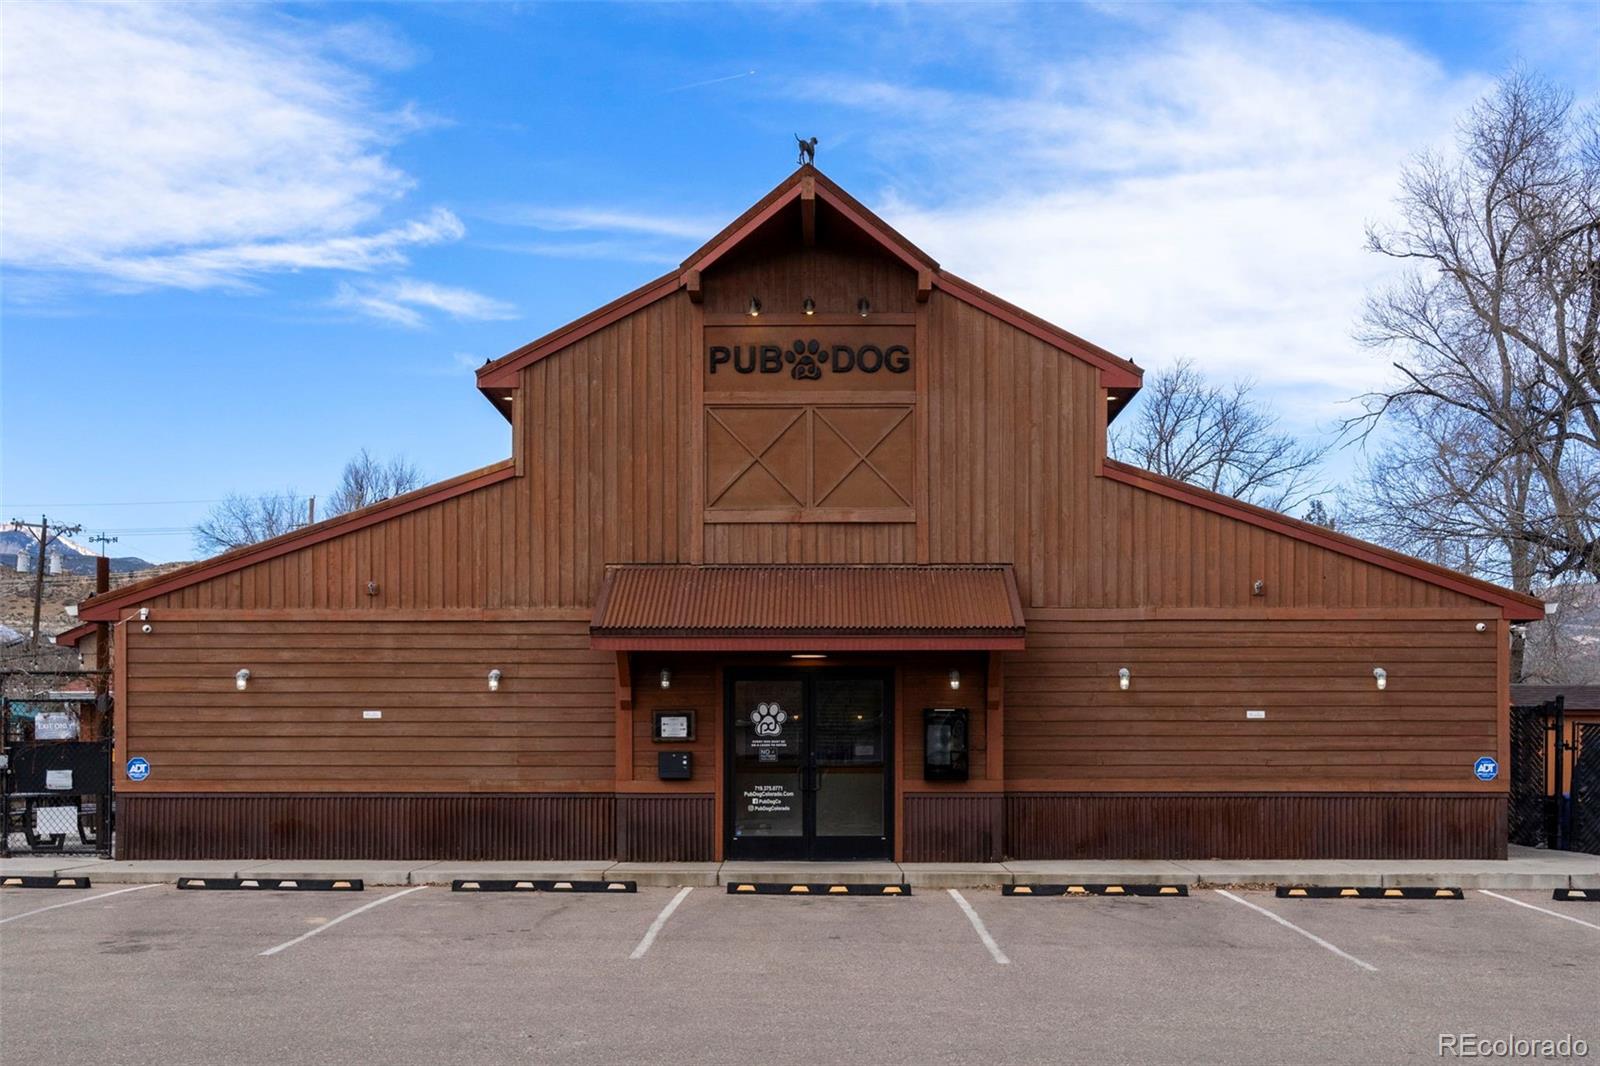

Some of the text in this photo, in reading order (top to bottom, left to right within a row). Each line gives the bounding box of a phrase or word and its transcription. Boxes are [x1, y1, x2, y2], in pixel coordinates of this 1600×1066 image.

[709, 345, 910, 374] PUB DOG
[129, 763, 147, 773] ADT
[1477, 763, 1495, 773] ADT
